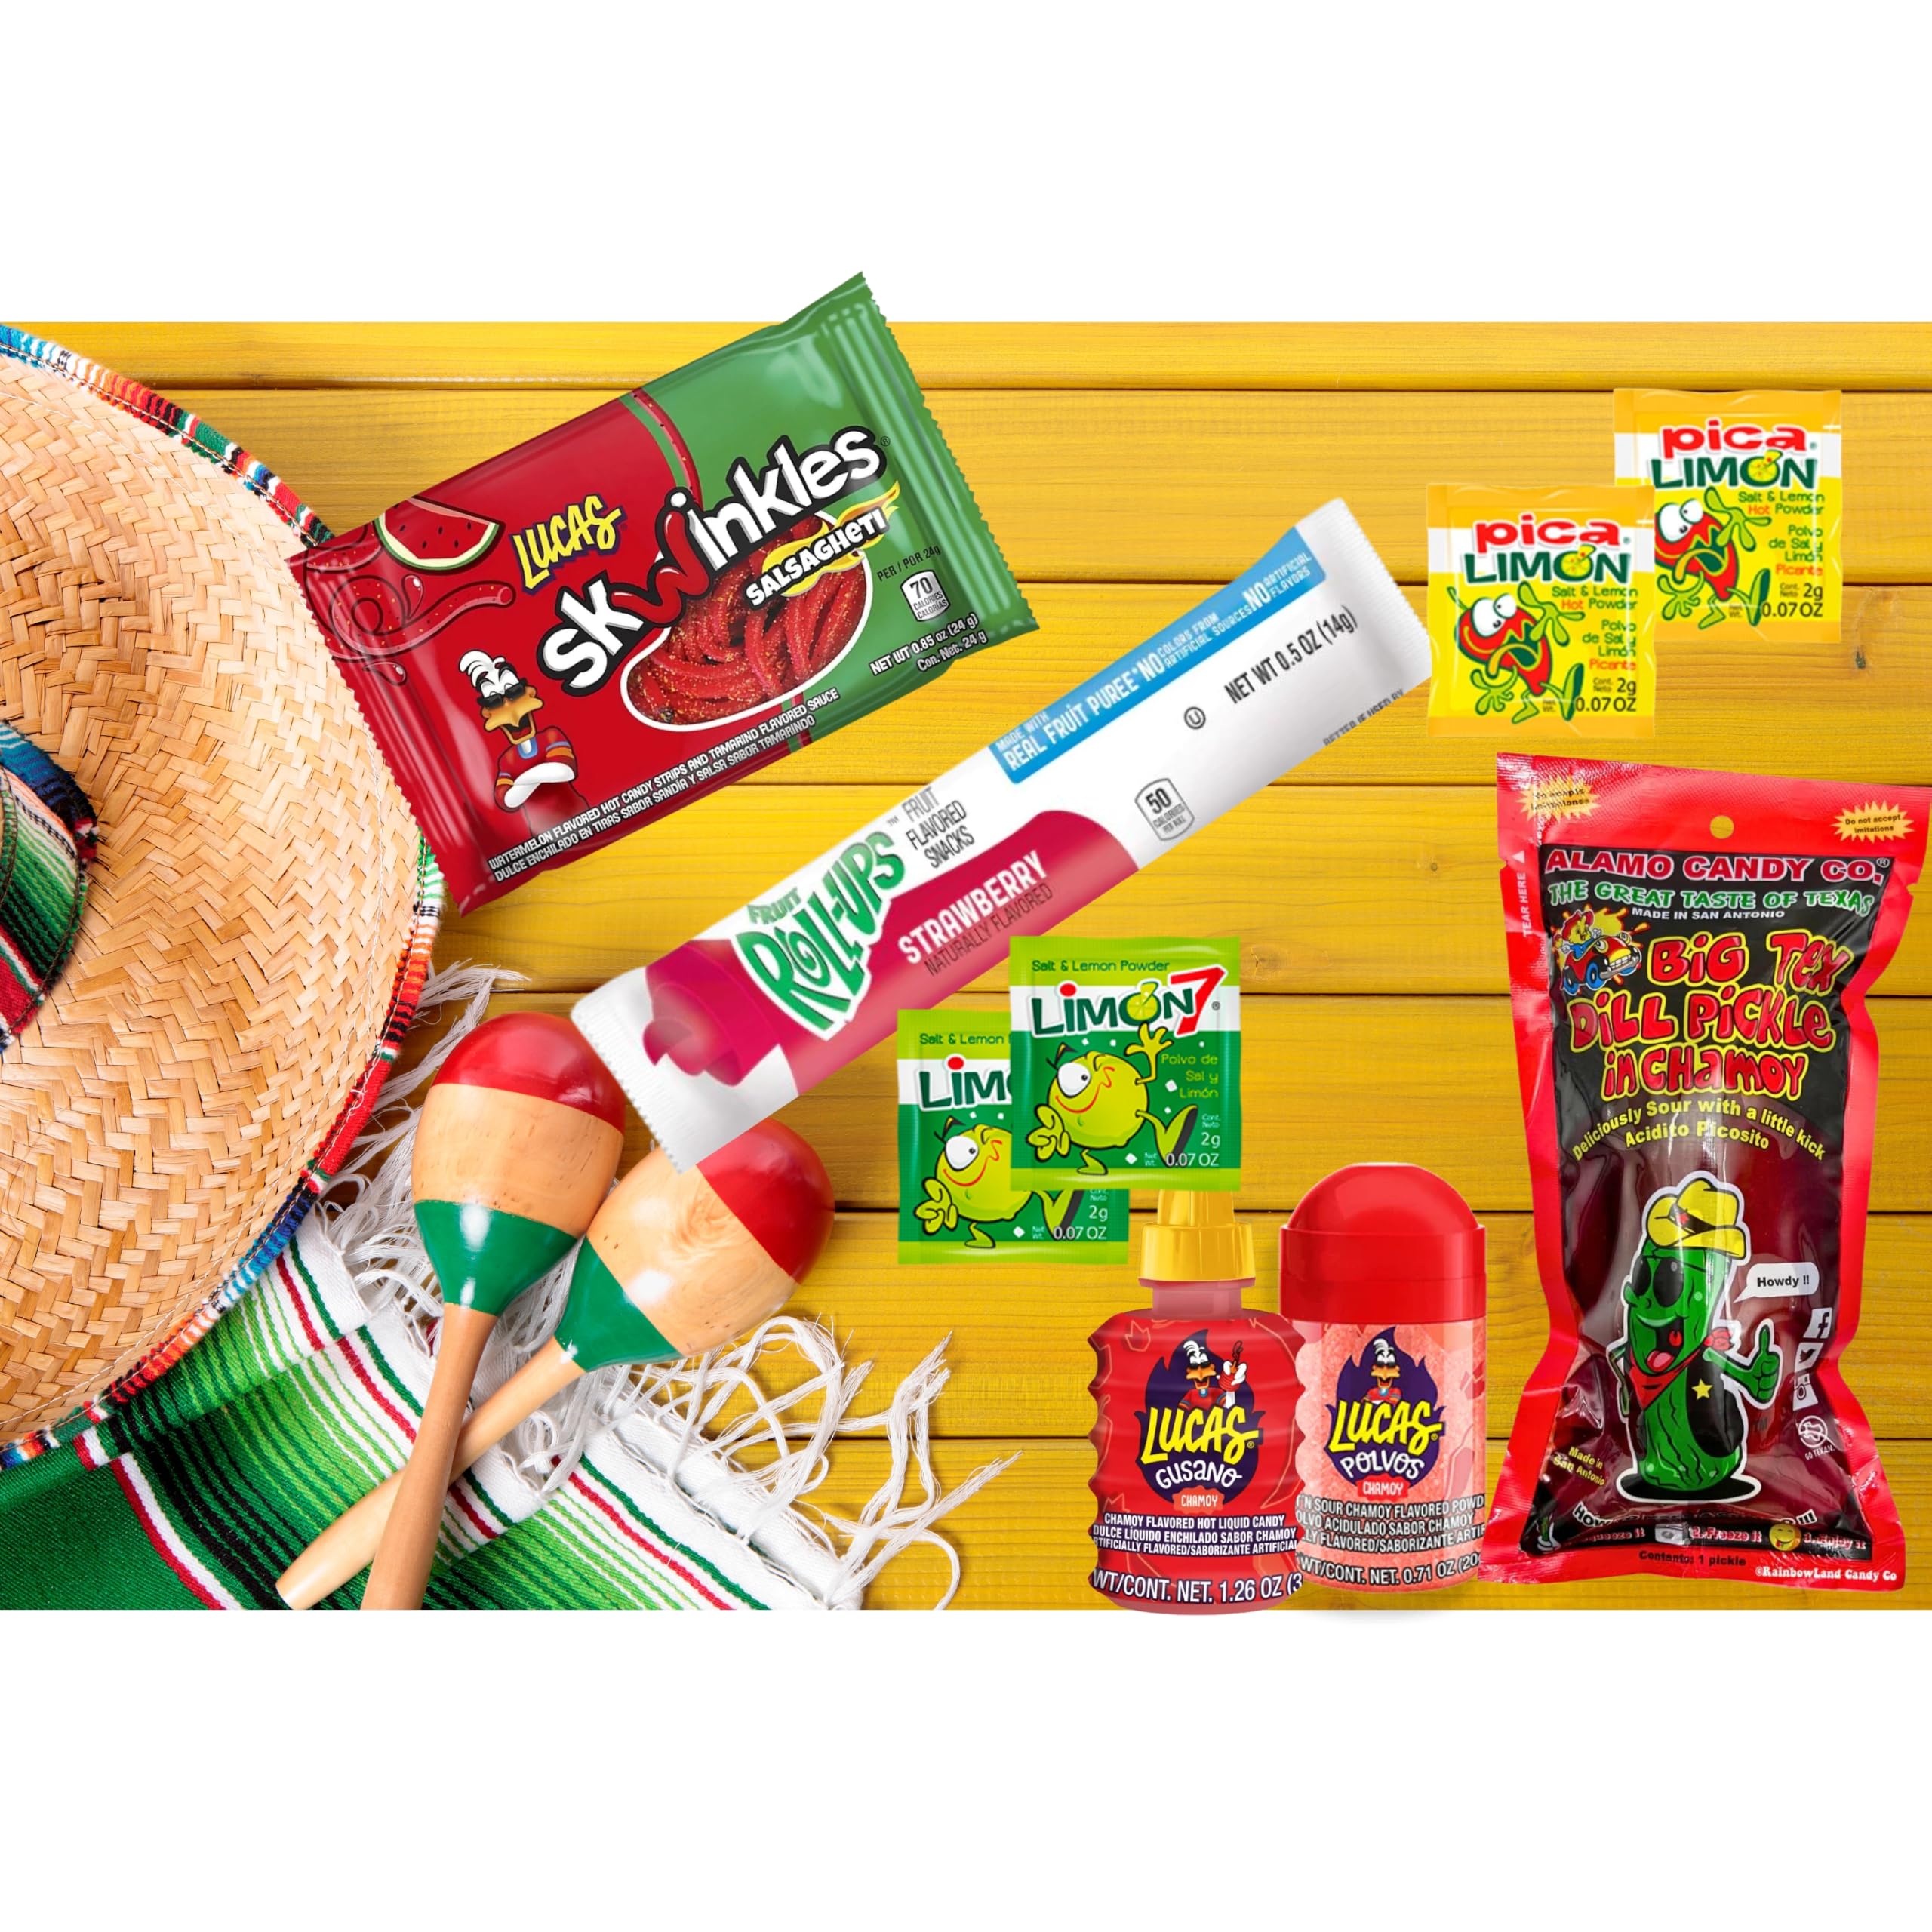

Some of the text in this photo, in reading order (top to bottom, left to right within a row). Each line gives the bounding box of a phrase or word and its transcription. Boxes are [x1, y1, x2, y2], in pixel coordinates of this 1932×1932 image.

[1662, 420, 1807, 459] pica
[513, 494, 622, 589] LUCAS
[1475, 515, 1620, 554] pica
[876, 545, 941, 582] PER POR 24g
[1263, 552, 1312, 587] ARTIFICIAL
[910, 576, 934, 599] 70
[1242, 582, 1272, 611] NO
[1271, 566, 1311, 598] FLAVORS
[1552, 586, 1576, 598] Salt
[1562, 600, 1583, 610] Hot
[1157, 612, 1220, 657] COLORS FROM
[1163, 605, 1254, 668] ARTIFICIAL SOURCES
[869, 635, 936, 675] NET WT 0.85
[917, 634, 978, 672] Con. Net. 24
[1137, 651, 1166, 681] NO
[1223, 605, 1359, 704] NET WT 0.5 OZ (14g)
[1617, 678, 1637, 696] 2g
[1024, 710, 1049, 732] WITH
[1002, 736, 1048, 771] REAL
[1043, 703, 1088, 744] FRUIT
[488, 688, 840, 870] WATERMELON FLAVORED HOT CANDY STRIPS AND TAMARIND FLAVORED SAUCE
[494, 715, 816, 882] DULCE ENCHILADO TIRAS SABOR SANDÍA SALSA SABOR TAMARINDO
[901, 786, 942, 823] FRUIT
[1145, 787, 1171, 814] 50
[906, 799, 968, 851] FLAVORED
[1873, 814, 1901, 823] accept
[924, 825, 975, 869] SNACKS
[1545, 848, 1675, 879] ALAMO
[1683, 855, 1815, 882] CANDY
[1517, 872, 1529, 903] HERE
[1549, 880, 1875, 916] THE GREAT TASTE OF TEXAS
[897, 849, 1048, 965] STRAWBERRY
[1520, 906, 1532, 937] TEAR
[1632, 908, 1786, 920] MADE IN SAN ANTONIO
[924, 882, 1054, 977] NATURALLY FLAVORED
[1032, 959, 1171, 973] Salt Lemon Powder
[919, 1032, 1004, 1046] Salt Lemon
[1201, 1132, 1220, 1149] 2g
[1572, 1098, 1826, 1161] Deliciously Sour with a little kick
[1625, 1121, 1770, 1151] Acidito Picosito
[1166, 1153, 1220, 1167] 0.07 OZ
[1089, 1205, 1109, 1222] 2g
[1054, 1226, 1107, 1240] 0.07 OZ
[1757, 1275, 1799, 1287] Howdy
[1141, 1406, 1260, 1465] LUCAS
[1328, 1401, 1443, 1455] LUCAS
[1340, 1450, 1425, 1480] POLVOS
[1568, 1447, 1595, 1465] Made
[1180, 1494, 1219, 1508] CHAMOY
[1362, 1481, 1404, 1496] CHAMOY
[1104, 1512, 1286, 1530] CHAMOY FLAVORED HOT LIQUID CANDY
[1315, 1497, 1343, 1514] SOUR
[1346, 1502, 1391, 1518] CHAMOY
[1394, 1502, 1449, 1518] FLAVORED
[1094, 1525, 1122, 1540] DULCE
[1164, 1531, 1218, 1544] ENCHILADO
[1220, 1530, 1253, 1543] SABOR
[1256, 1527, 1297, 1540] CHAMOY
[1324, 1518, 1387, 1536] ACIDULADO
[1389, 1519, 1426, 1537] SABOR
[1428, 1512, 1475, 1532] CHAMOY
[1143, 1541, 1251, 1555] FLAVORED/SABORIZANTE
[1709, 1556, 1746, 1566] pickle
[1094, 1570, 1282, 1603] WT/CONT. NET. 1.26 OZ
[1371, 1567, 1400, 1585] NET.
[1403, 1564, 1432, 1583] 0.71
[1437, 1559, 1456, 1578] OZ
[1845, 1570, 1897, 1582] Candy Co
